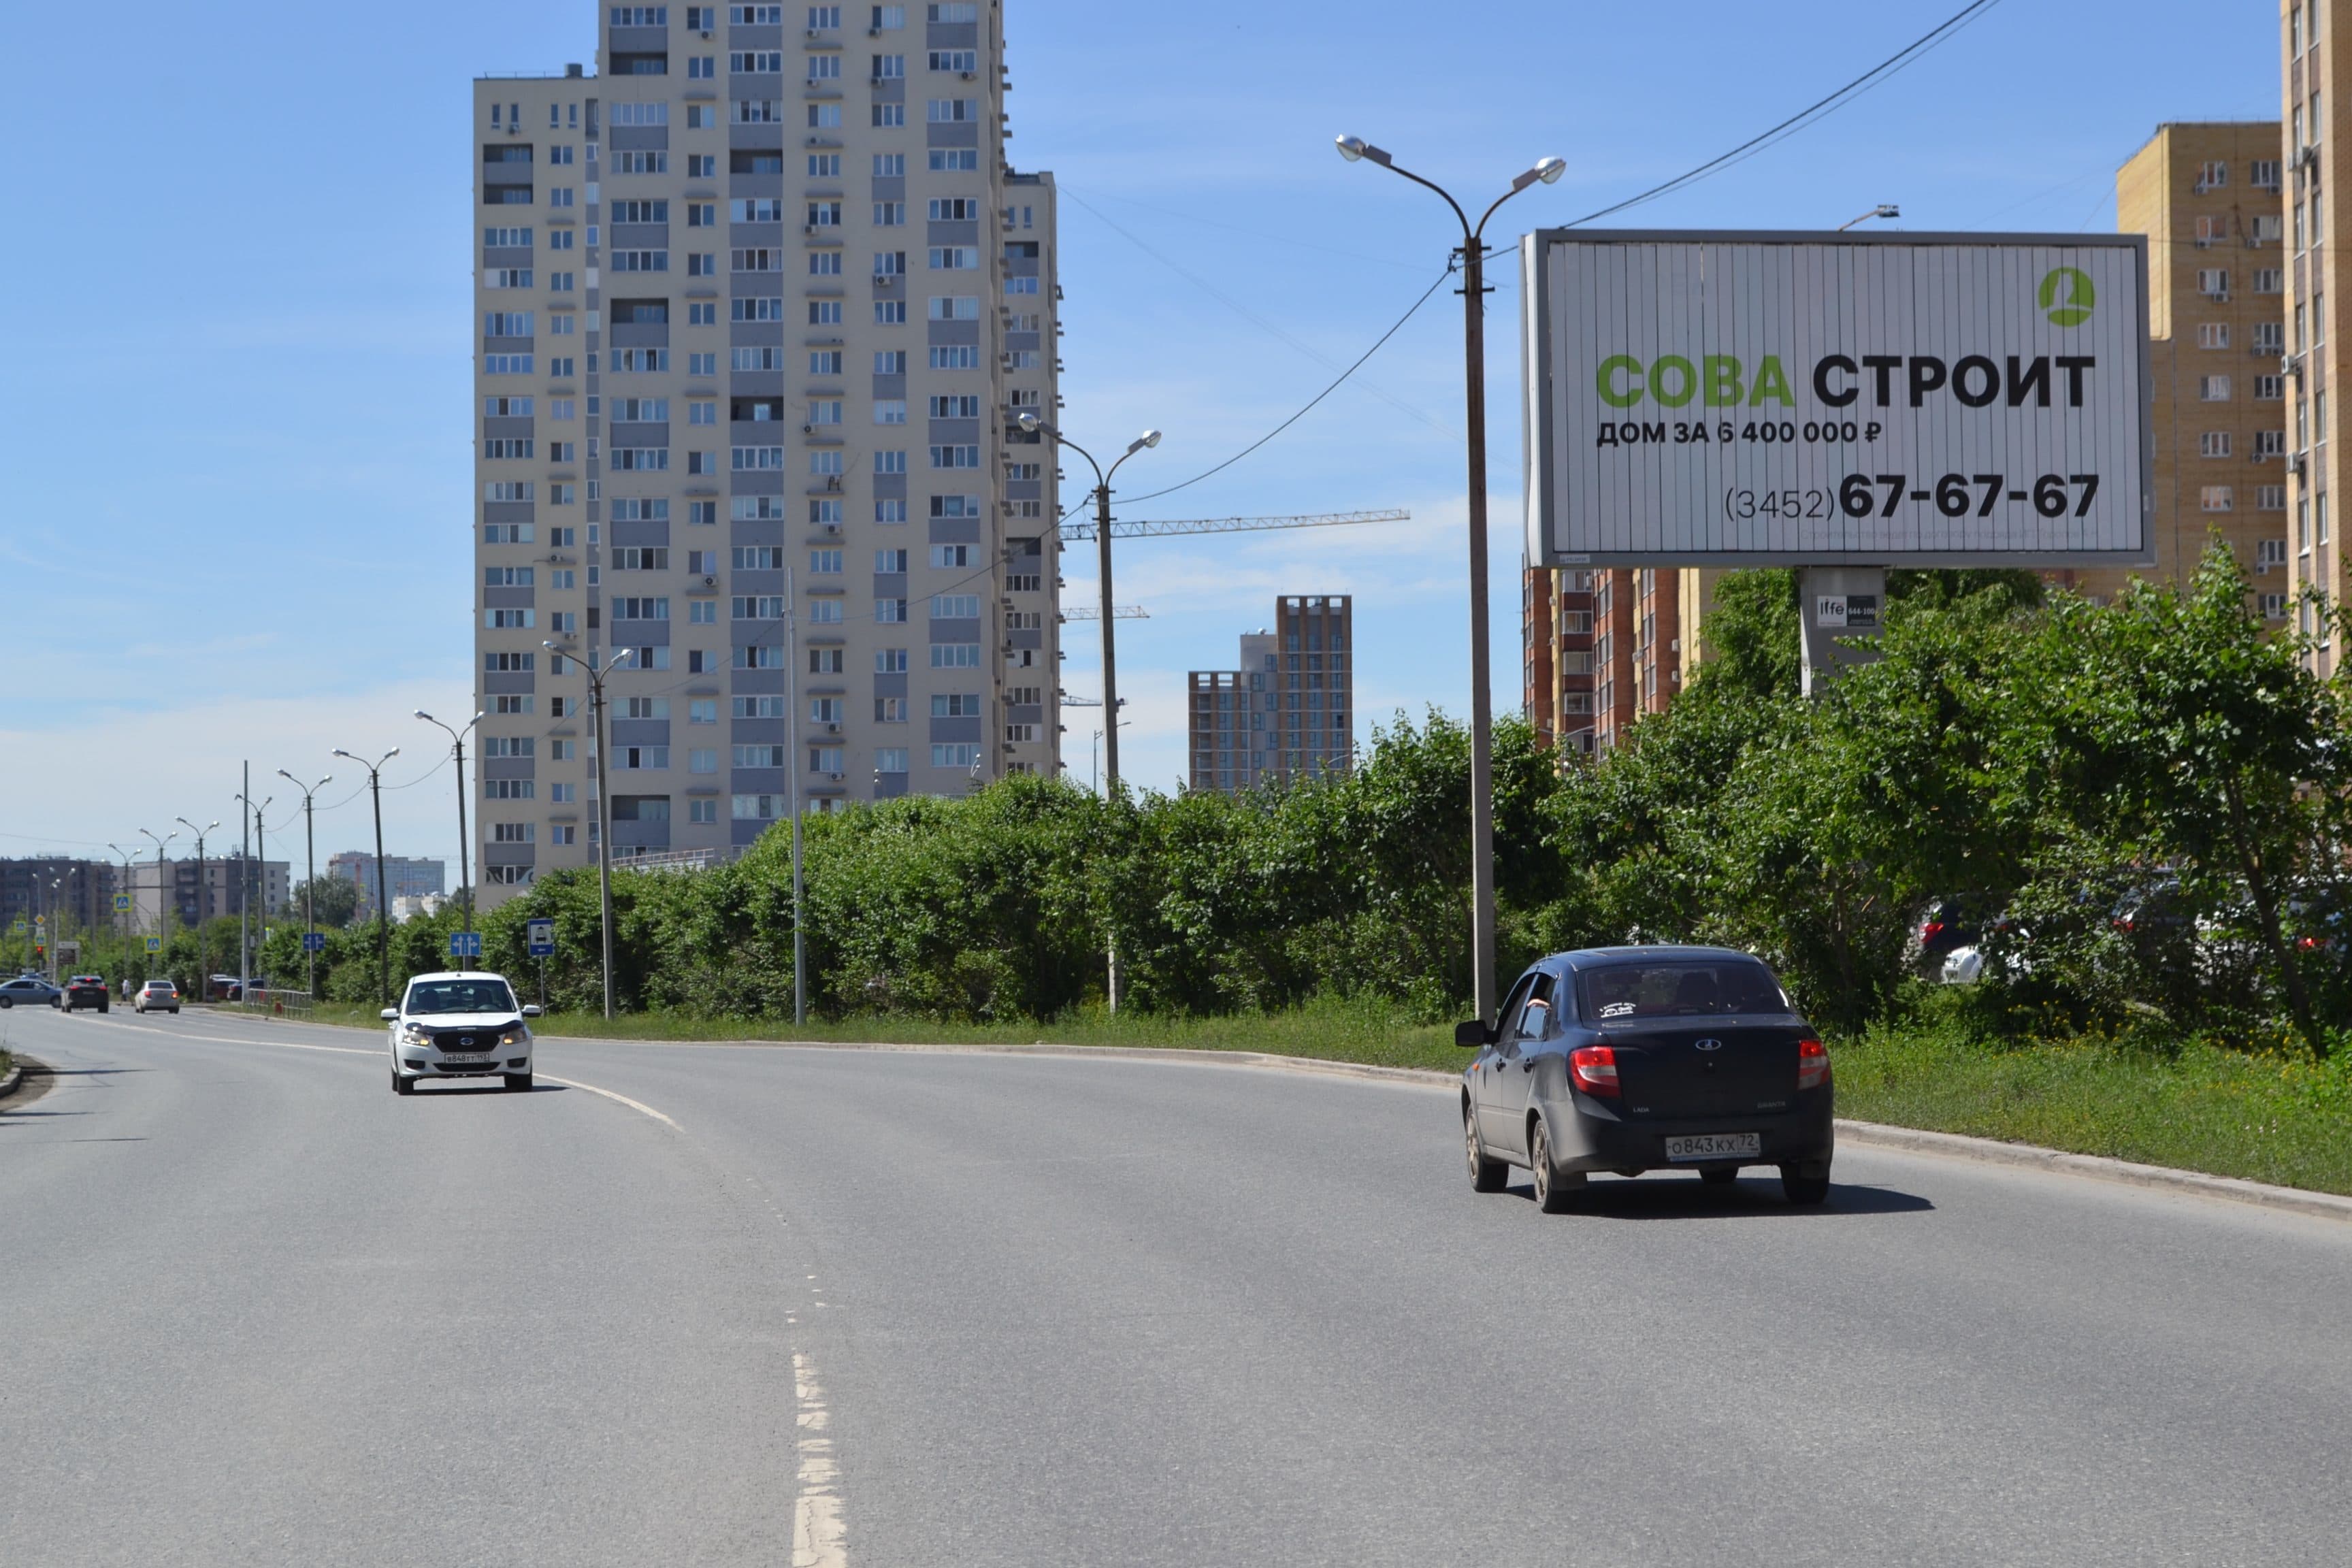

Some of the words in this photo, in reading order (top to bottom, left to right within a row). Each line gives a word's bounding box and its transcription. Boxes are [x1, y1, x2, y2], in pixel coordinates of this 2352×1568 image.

[1597, 354, 1795, 408] СОВА
[1813, 354, 2096, 408] СТРОИТ
[1596, 422, 1667, 448] ДОМ
[1673, 421, 1710, 443] ЗА
[1716, 421, 1734, 443] 6
[1741, 421, 1796, 443] 400
[1803, 421, 1858, 443] 000
[1839, 473, 2100, 519] 67-67-67
[1740, 1134, 1754, 1147] 72
